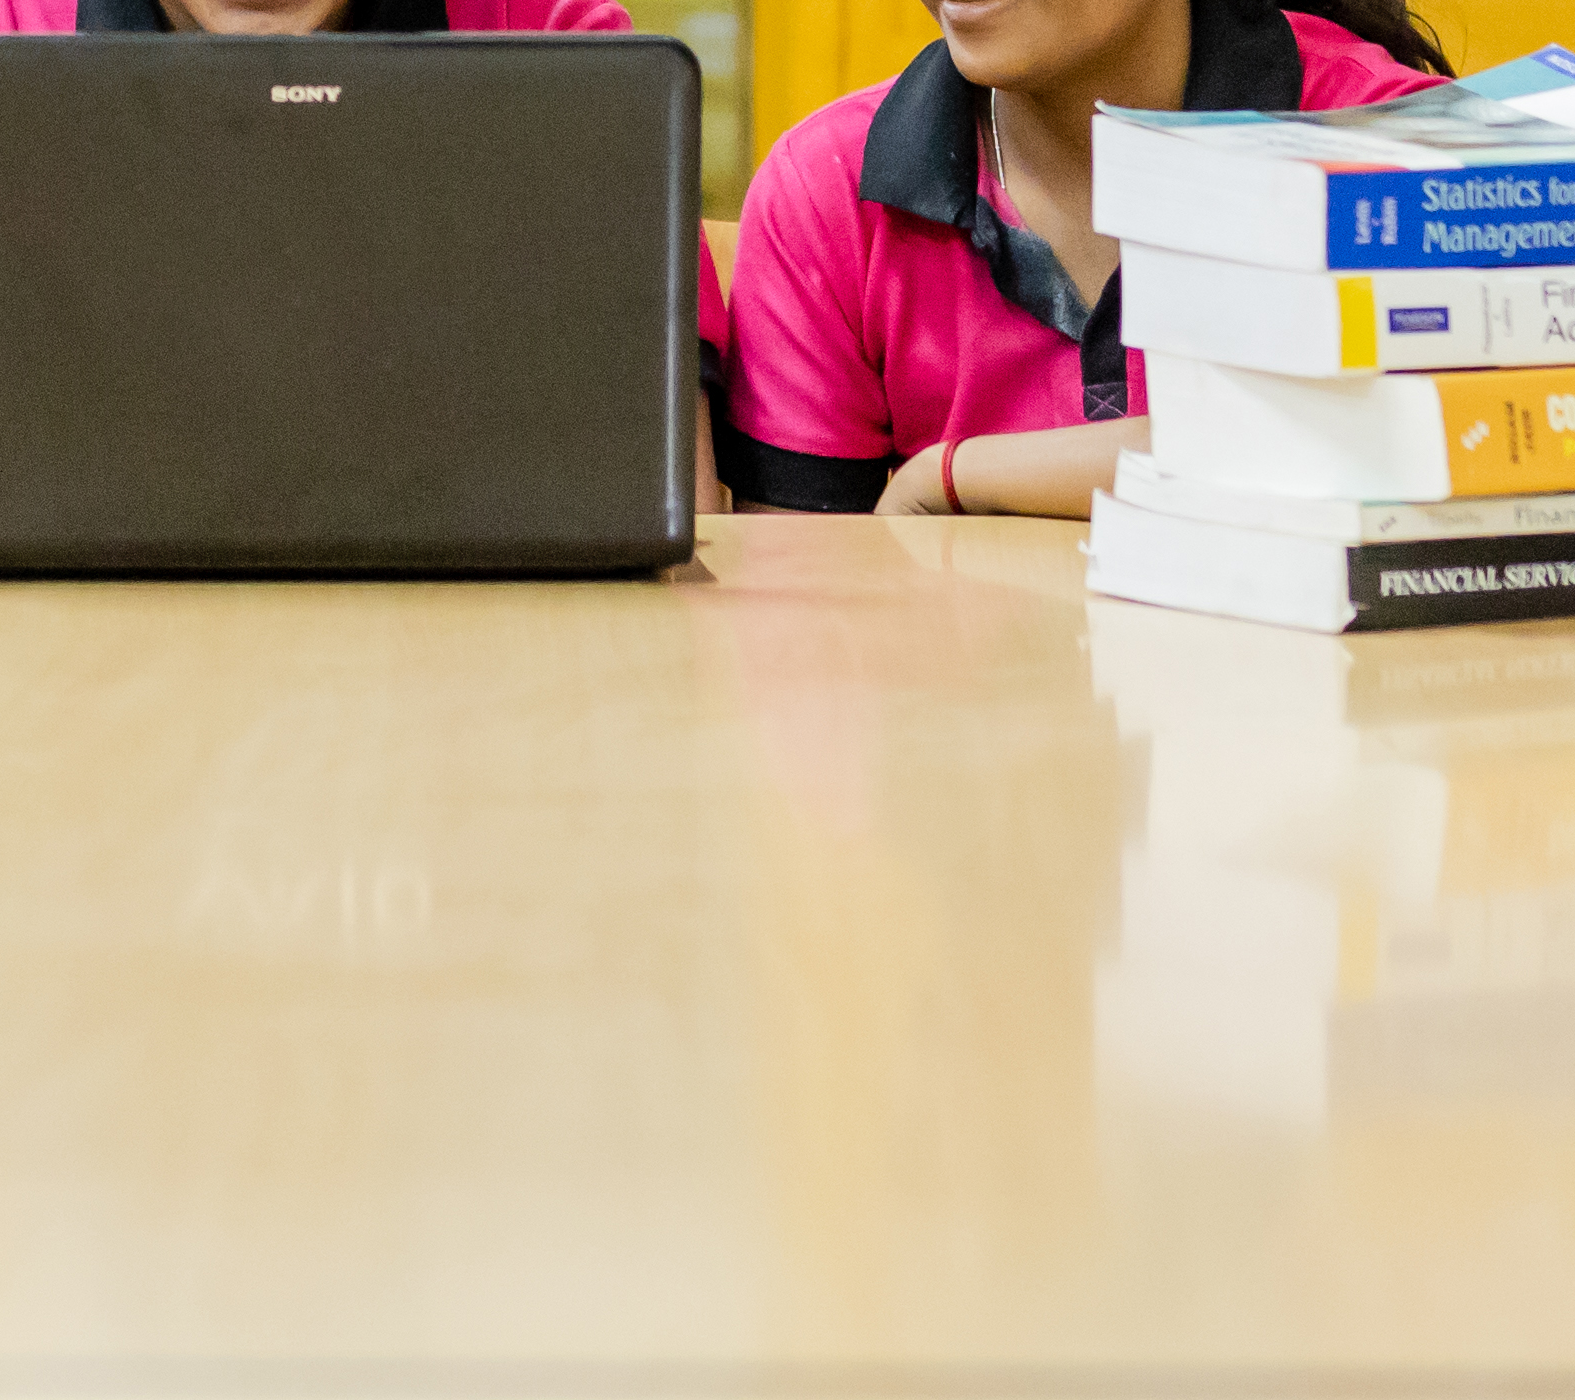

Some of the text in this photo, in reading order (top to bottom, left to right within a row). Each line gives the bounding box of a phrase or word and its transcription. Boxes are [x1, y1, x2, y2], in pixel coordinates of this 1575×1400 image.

[271, 85, 341, 103] SONY
[1422, 175, 1540, 212] Statistics
[1380, 563, 1500, 597] FINANCIAL
